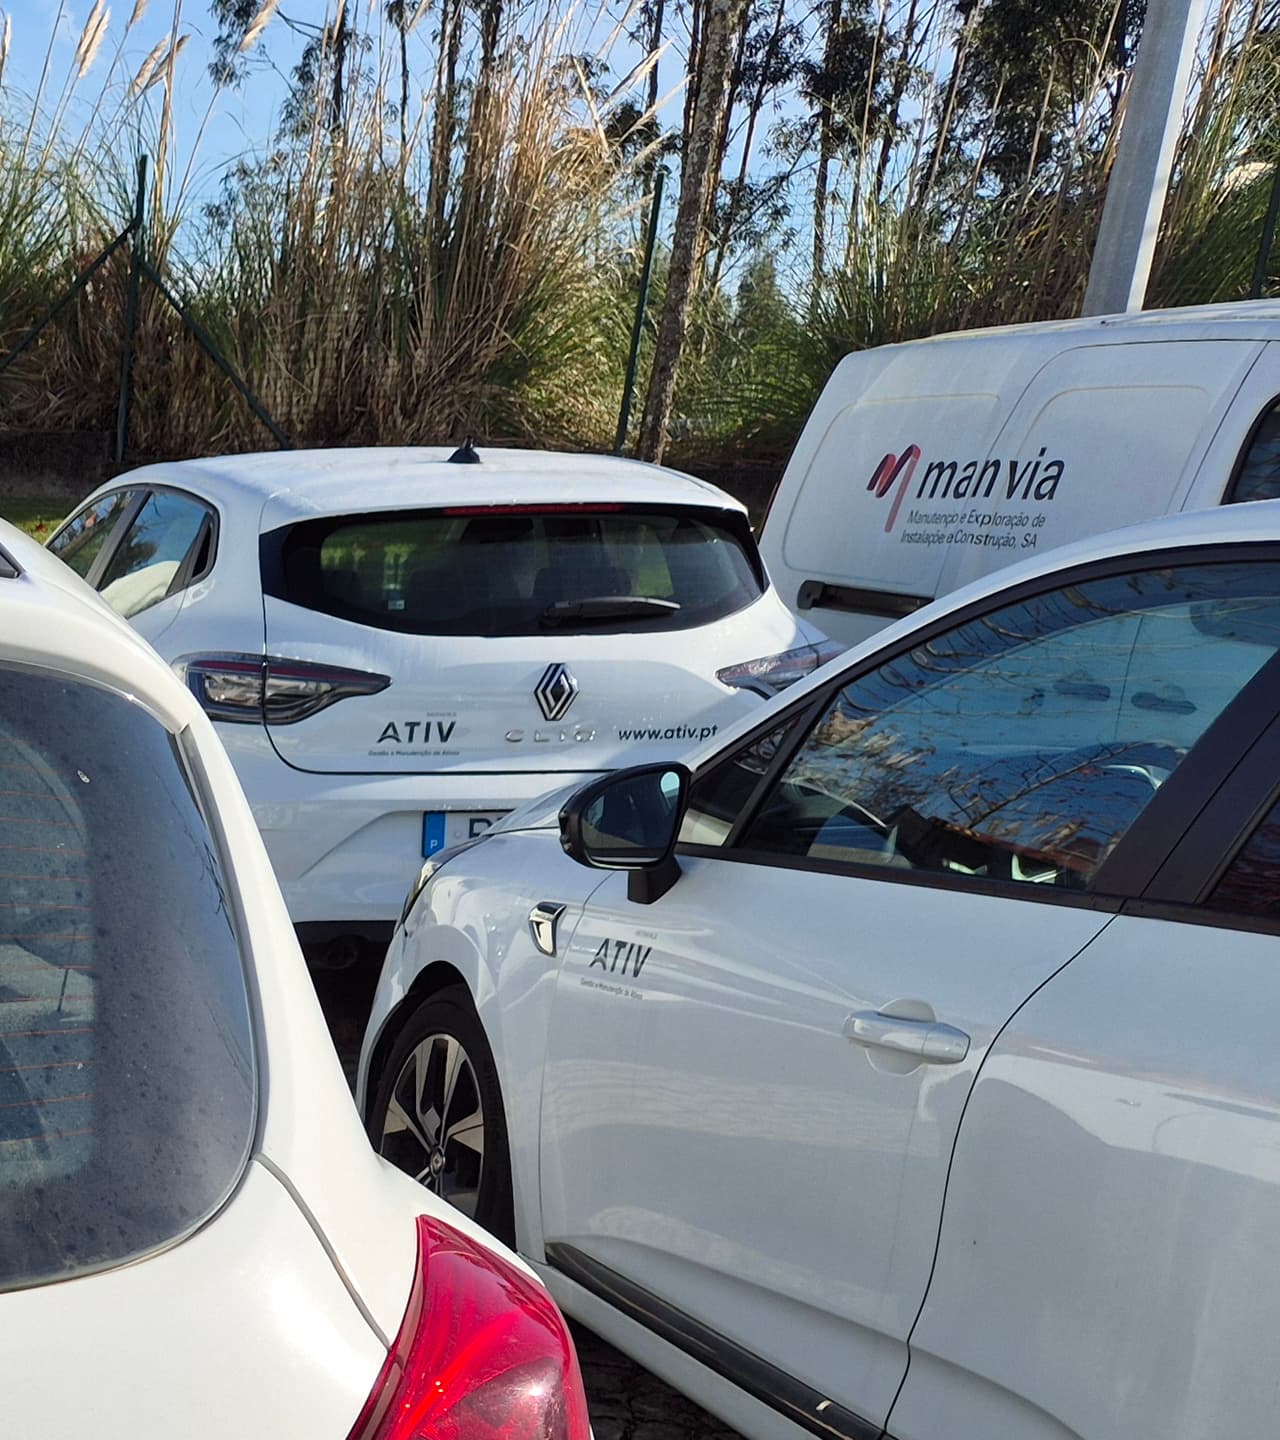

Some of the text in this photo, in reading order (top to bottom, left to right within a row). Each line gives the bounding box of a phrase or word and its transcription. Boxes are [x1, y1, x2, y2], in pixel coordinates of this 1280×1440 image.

[916, 447, 1065, 500] manvia
[967, 509, 1029, 530] Exploração
[1031, 512, 1047, 528] de
[1020, 532, 1038, 549] SA
[377, 721, 457, 743] ATIV
[504, 727, 596, 743] CLIO
[618, 724, 719, 742] www.ativ.pt
[430, 840, 438, 849] P
[588, 937, 652, 978] ATIV
